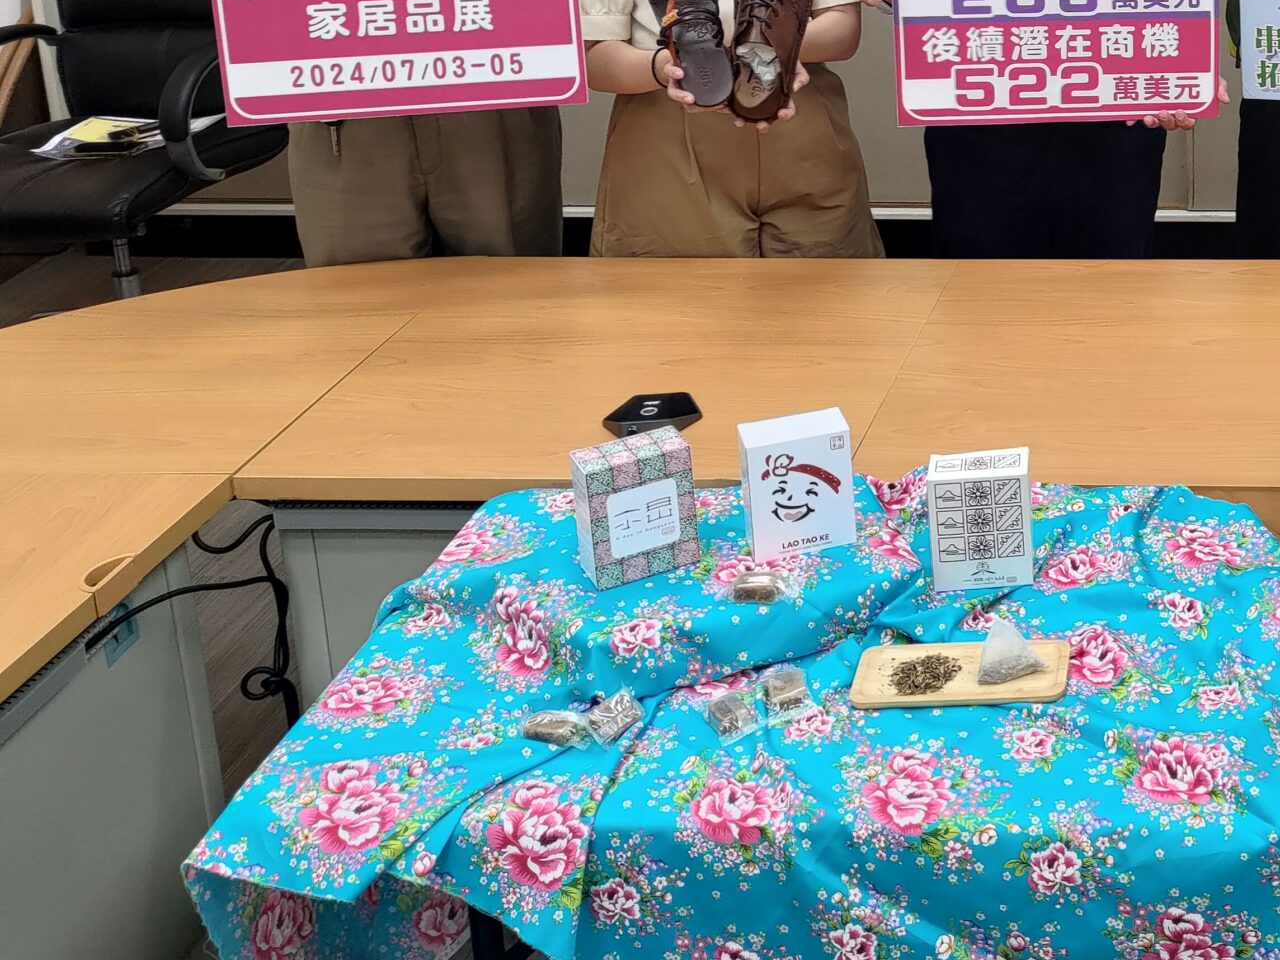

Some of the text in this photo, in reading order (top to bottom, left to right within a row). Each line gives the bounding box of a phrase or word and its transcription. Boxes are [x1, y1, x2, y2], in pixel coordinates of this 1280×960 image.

[921, 22, 1180, 64] 後續潛在商機
[289, 52, 526, 89] 2024/07/03-05
[954, 64, 1202, 109] 522 萬美元
[782, 540, 799, 550] LAO
[801, 536, 818, 545] TAO
[819, 533, 830, 541] KE
